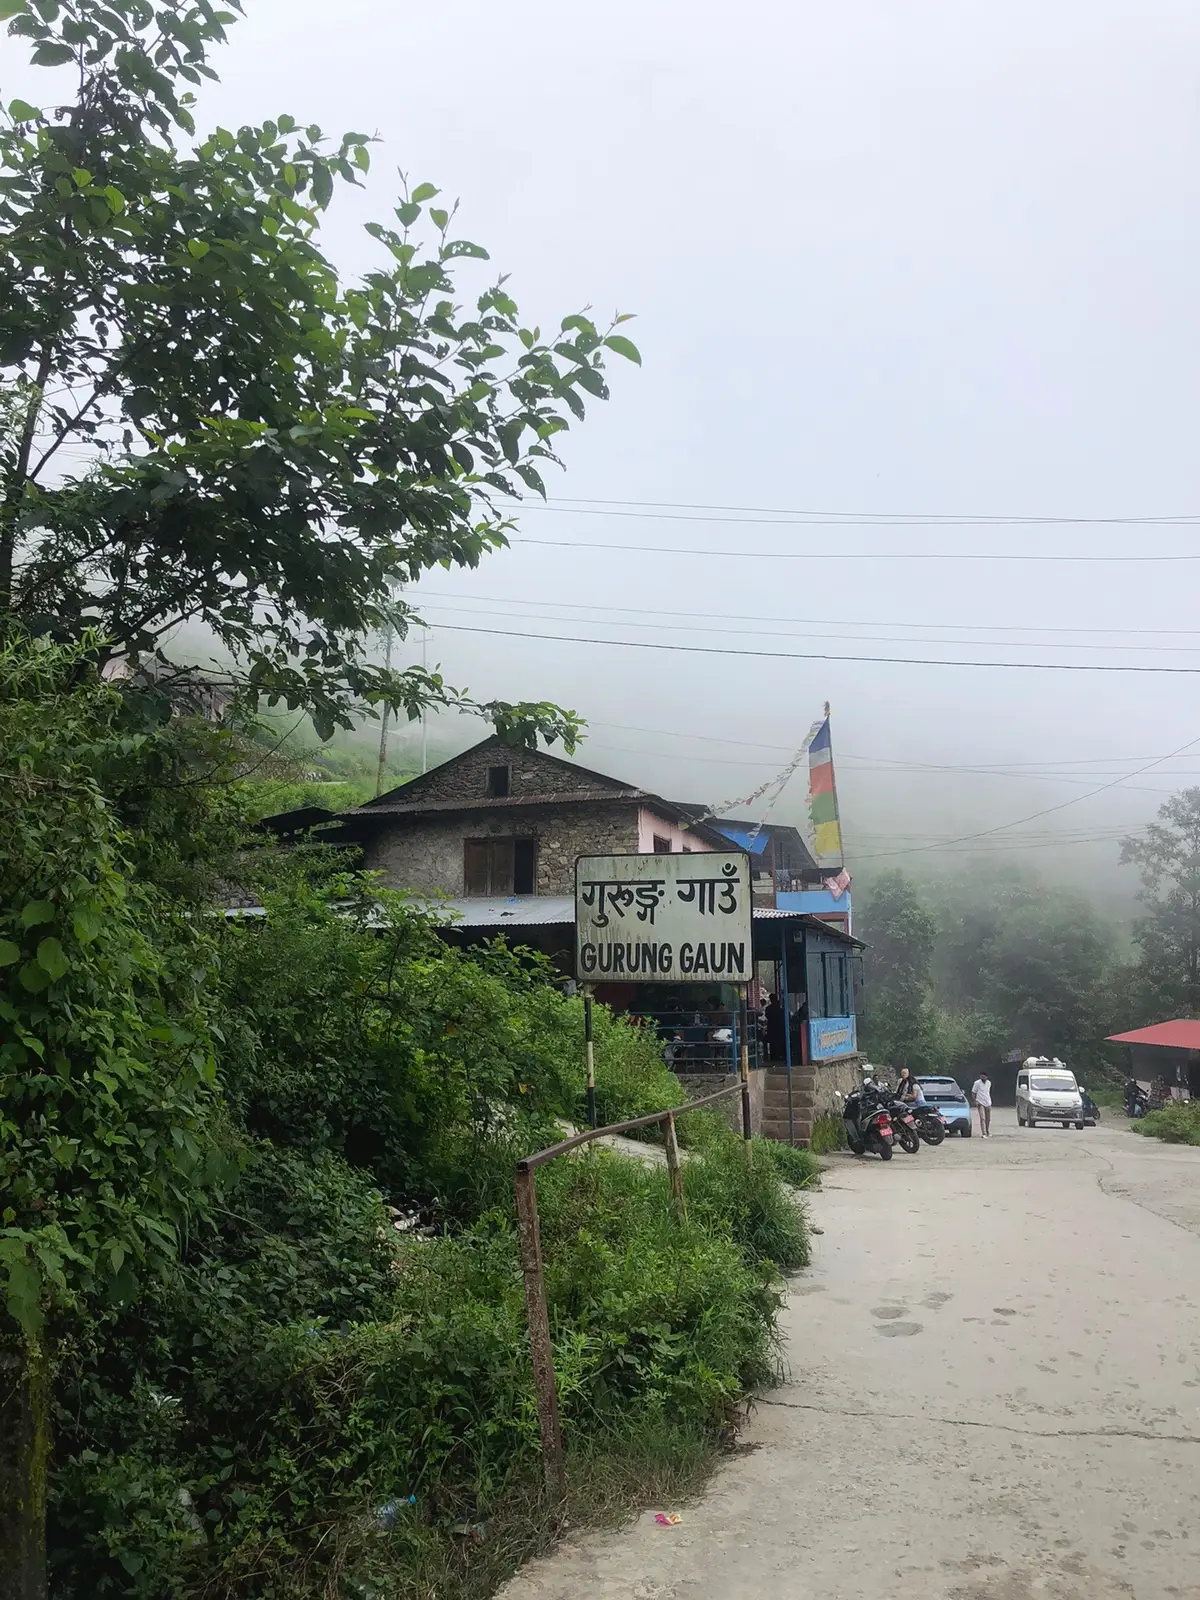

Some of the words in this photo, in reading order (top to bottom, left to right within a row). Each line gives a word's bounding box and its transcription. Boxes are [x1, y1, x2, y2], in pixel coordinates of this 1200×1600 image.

[676, 862, 741, 916] गाउँ
[580, 942, 673, 974] GURUNG
[679, 942, 745, 974] GAUN
